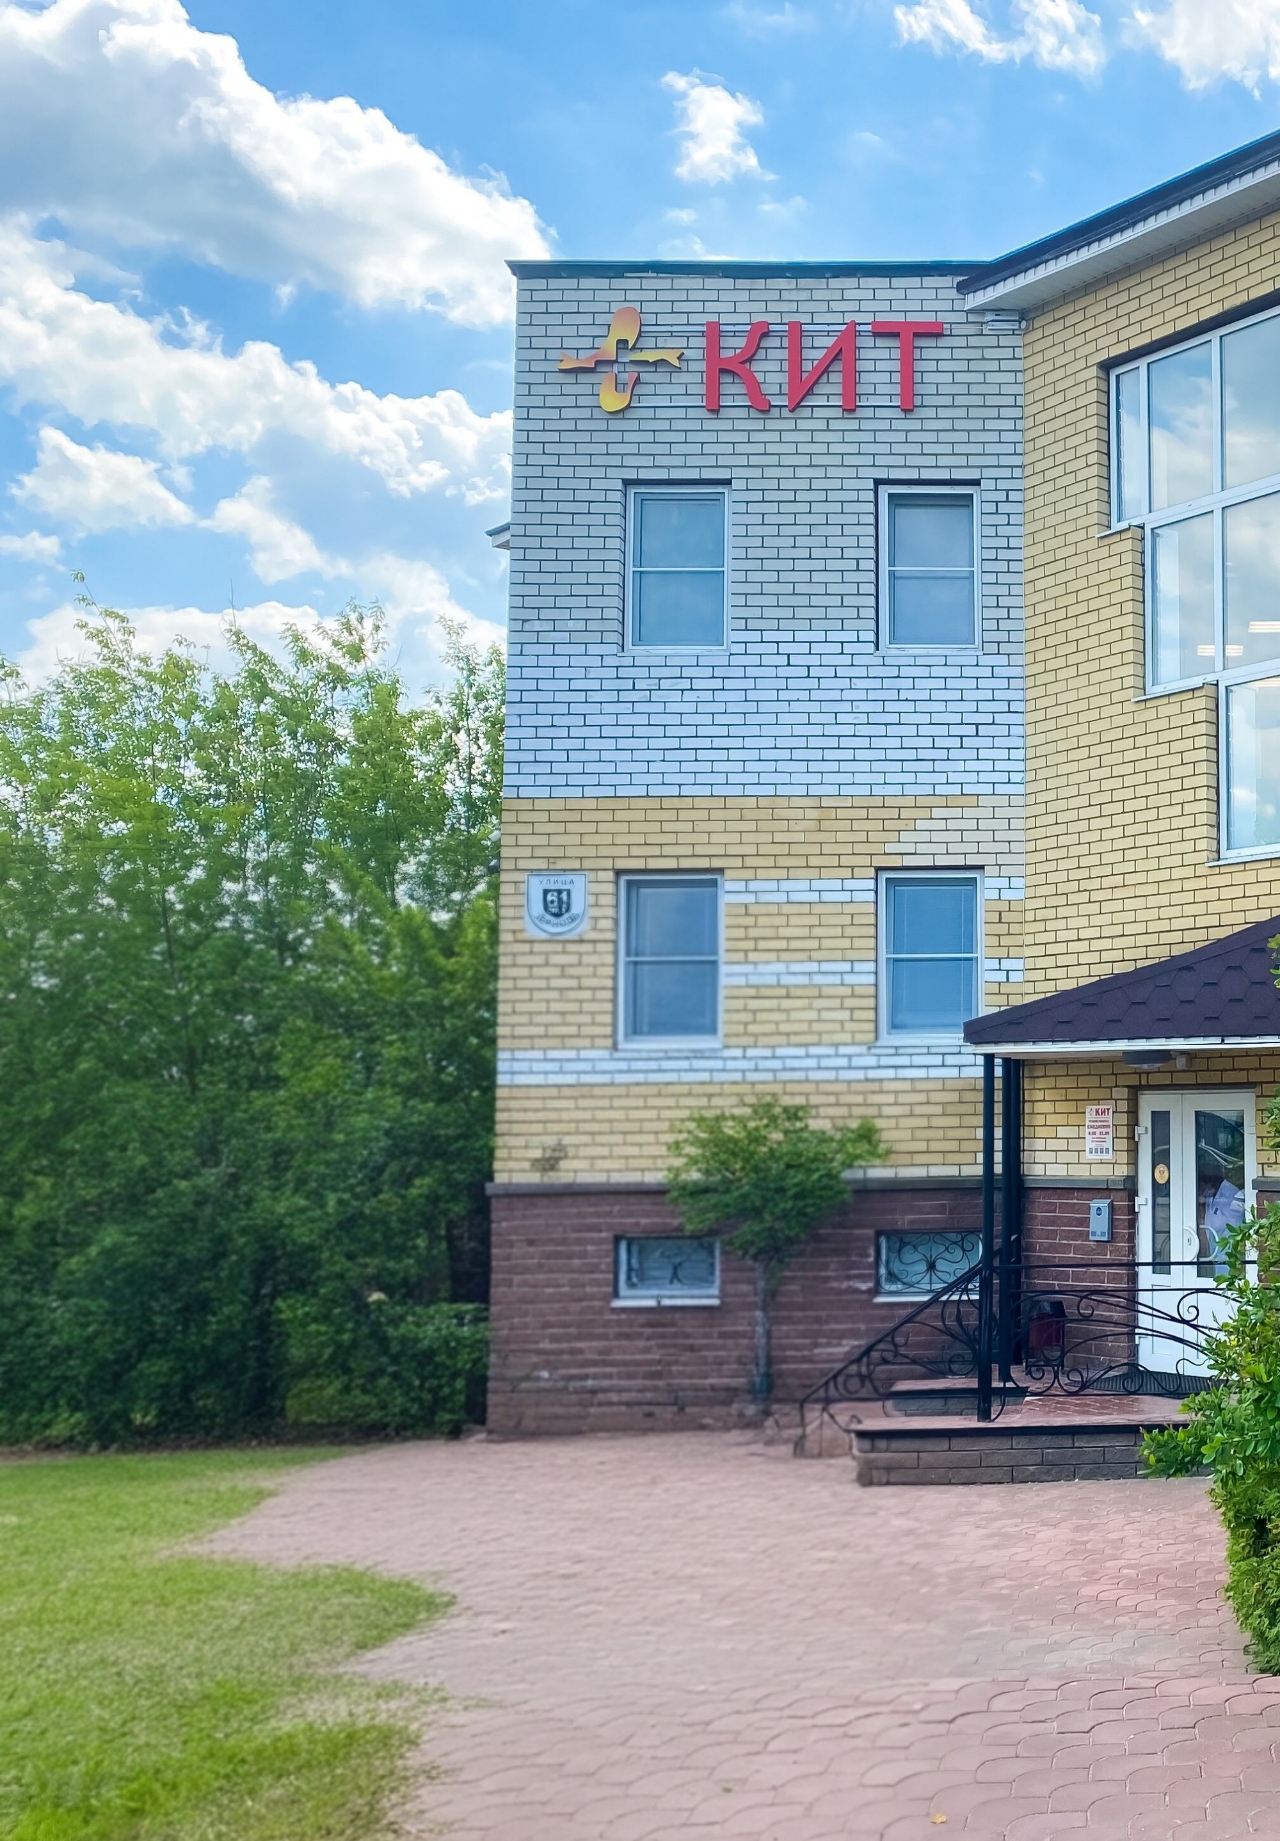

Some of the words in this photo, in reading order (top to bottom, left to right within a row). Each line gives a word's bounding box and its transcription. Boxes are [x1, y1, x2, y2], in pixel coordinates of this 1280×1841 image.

[705, 319, 944, 412] КИТ
[546, 891, 567, 908] 61
[1095, 1108, 1110, 1116] КИТ
